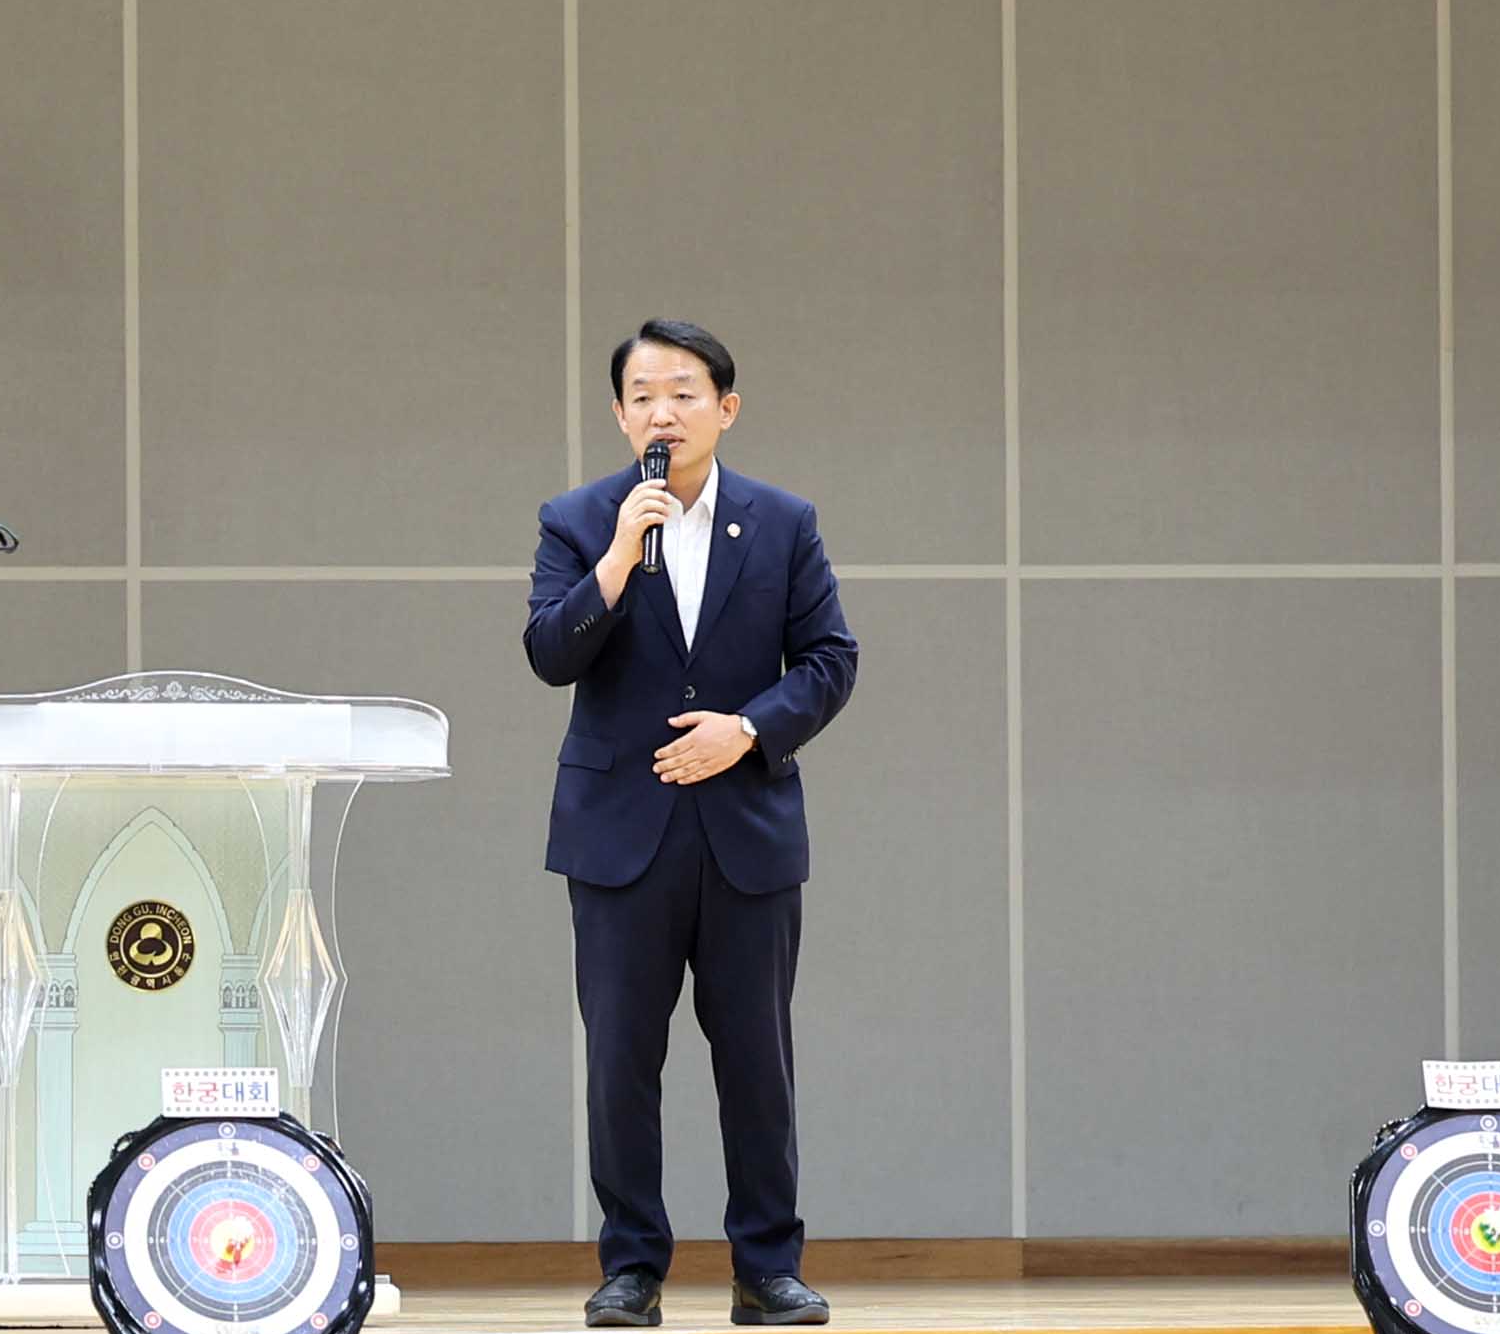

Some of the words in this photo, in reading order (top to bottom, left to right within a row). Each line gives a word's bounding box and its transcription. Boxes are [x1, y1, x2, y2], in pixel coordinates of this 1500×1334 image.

[109, 912, 133, 944] DONG
[155, 904, 193, 944] INCHEON
[171, 1080, 270, 1104] 한궁대회
